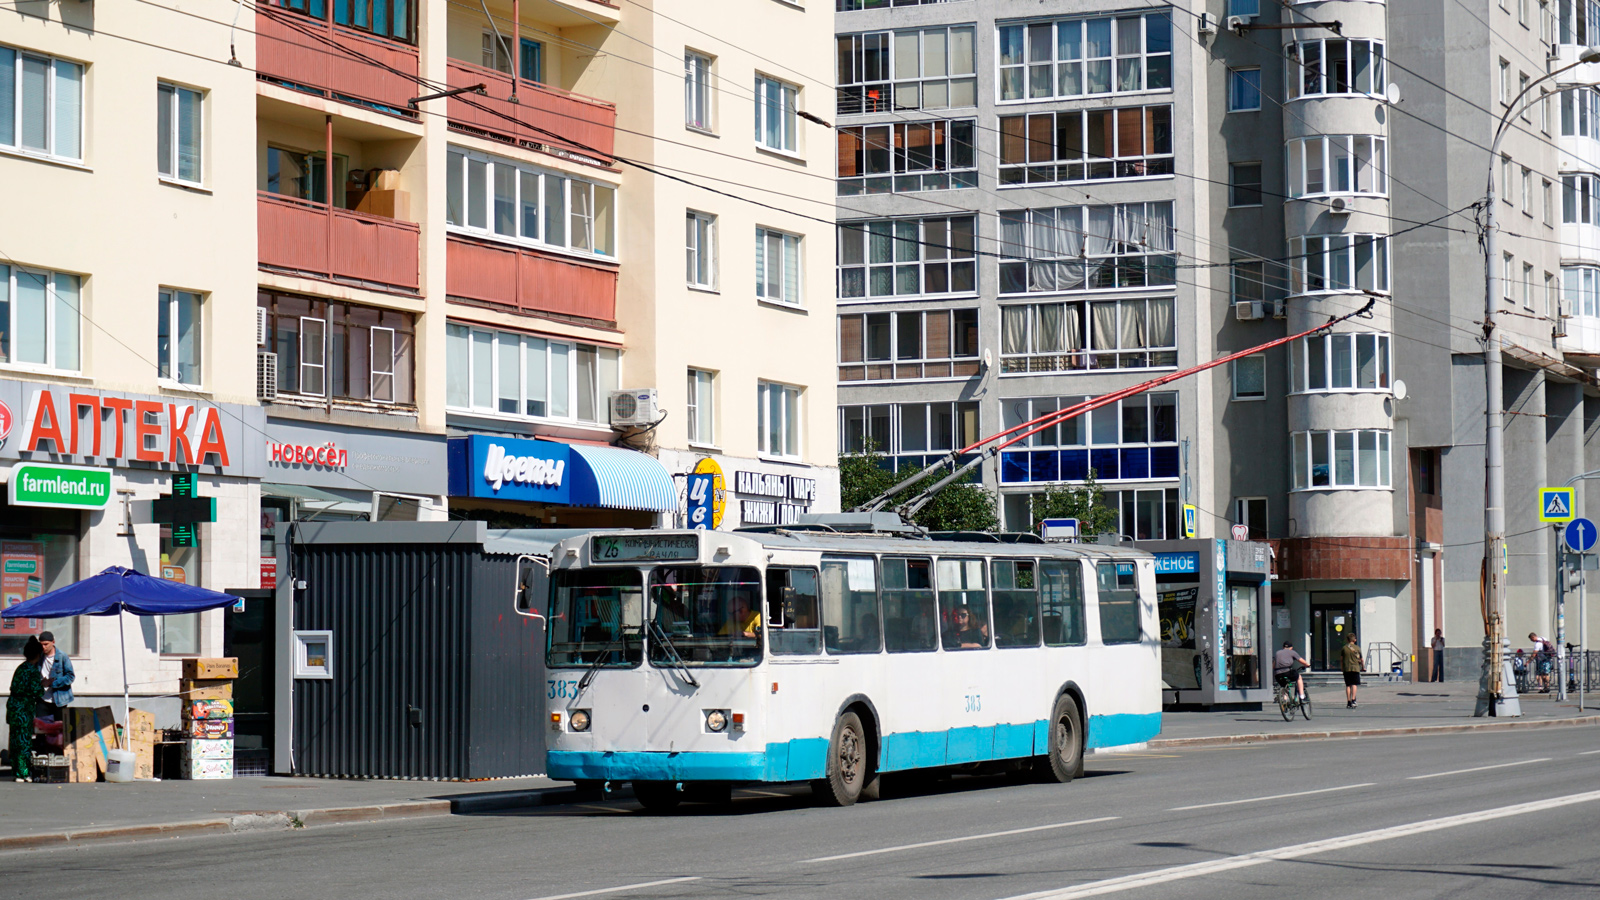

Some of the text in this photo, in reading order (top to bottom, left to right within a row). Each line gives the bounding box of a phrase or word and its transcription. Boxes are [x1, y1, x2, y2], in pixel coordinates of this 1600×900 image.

[26, 390, 230, 467] АПТЕКА
[484, 443, 565, 490] Цветы
[22, 473, 105, 497] farmlend.ru
[738, 471, 787, 497] КАЛЬЯНЫ
[793, 477, 816, 501] VAPE
[744, 500, 775, 524] ЖИЖИ
[604, 540, 619, 558] 26
[1217, 574, 1226, 657] МОРОЖЕНОЕ
[547, 679, 578, 700] 383
[964, 694, 981, 712] 383
